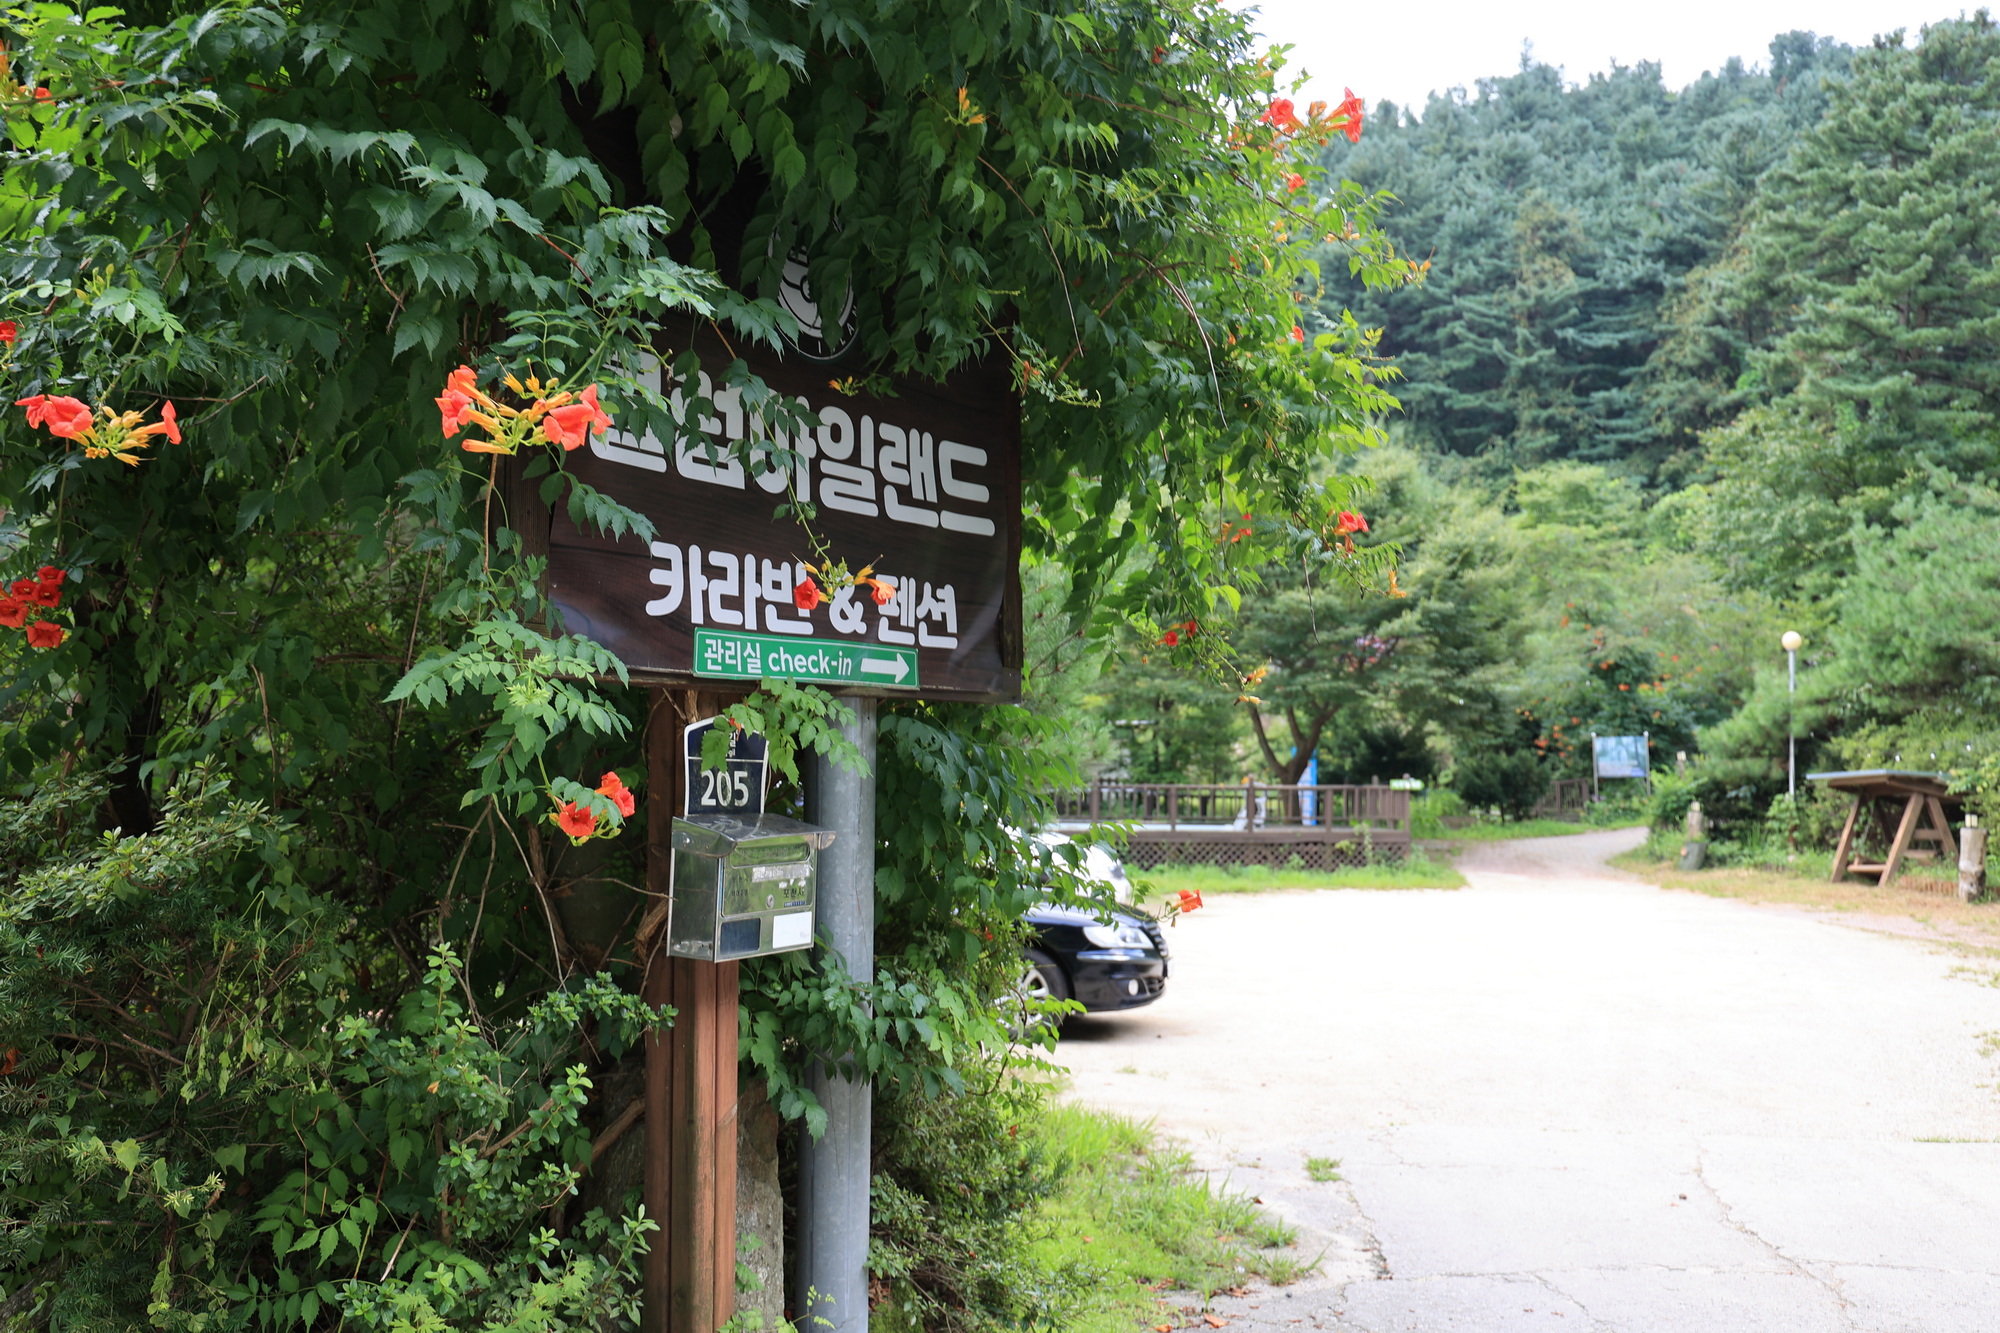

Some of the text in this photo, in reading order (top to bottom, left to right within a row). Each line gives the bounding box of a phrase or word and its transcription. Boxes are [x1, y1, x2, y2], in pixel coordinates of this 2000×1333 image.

[645, 540, 814, 635] 카라반
[875, 573, 959, 650] 펜션
[703, 637, 853, 676] 관리실 check-in
[700, 769, 749, 807] 205
